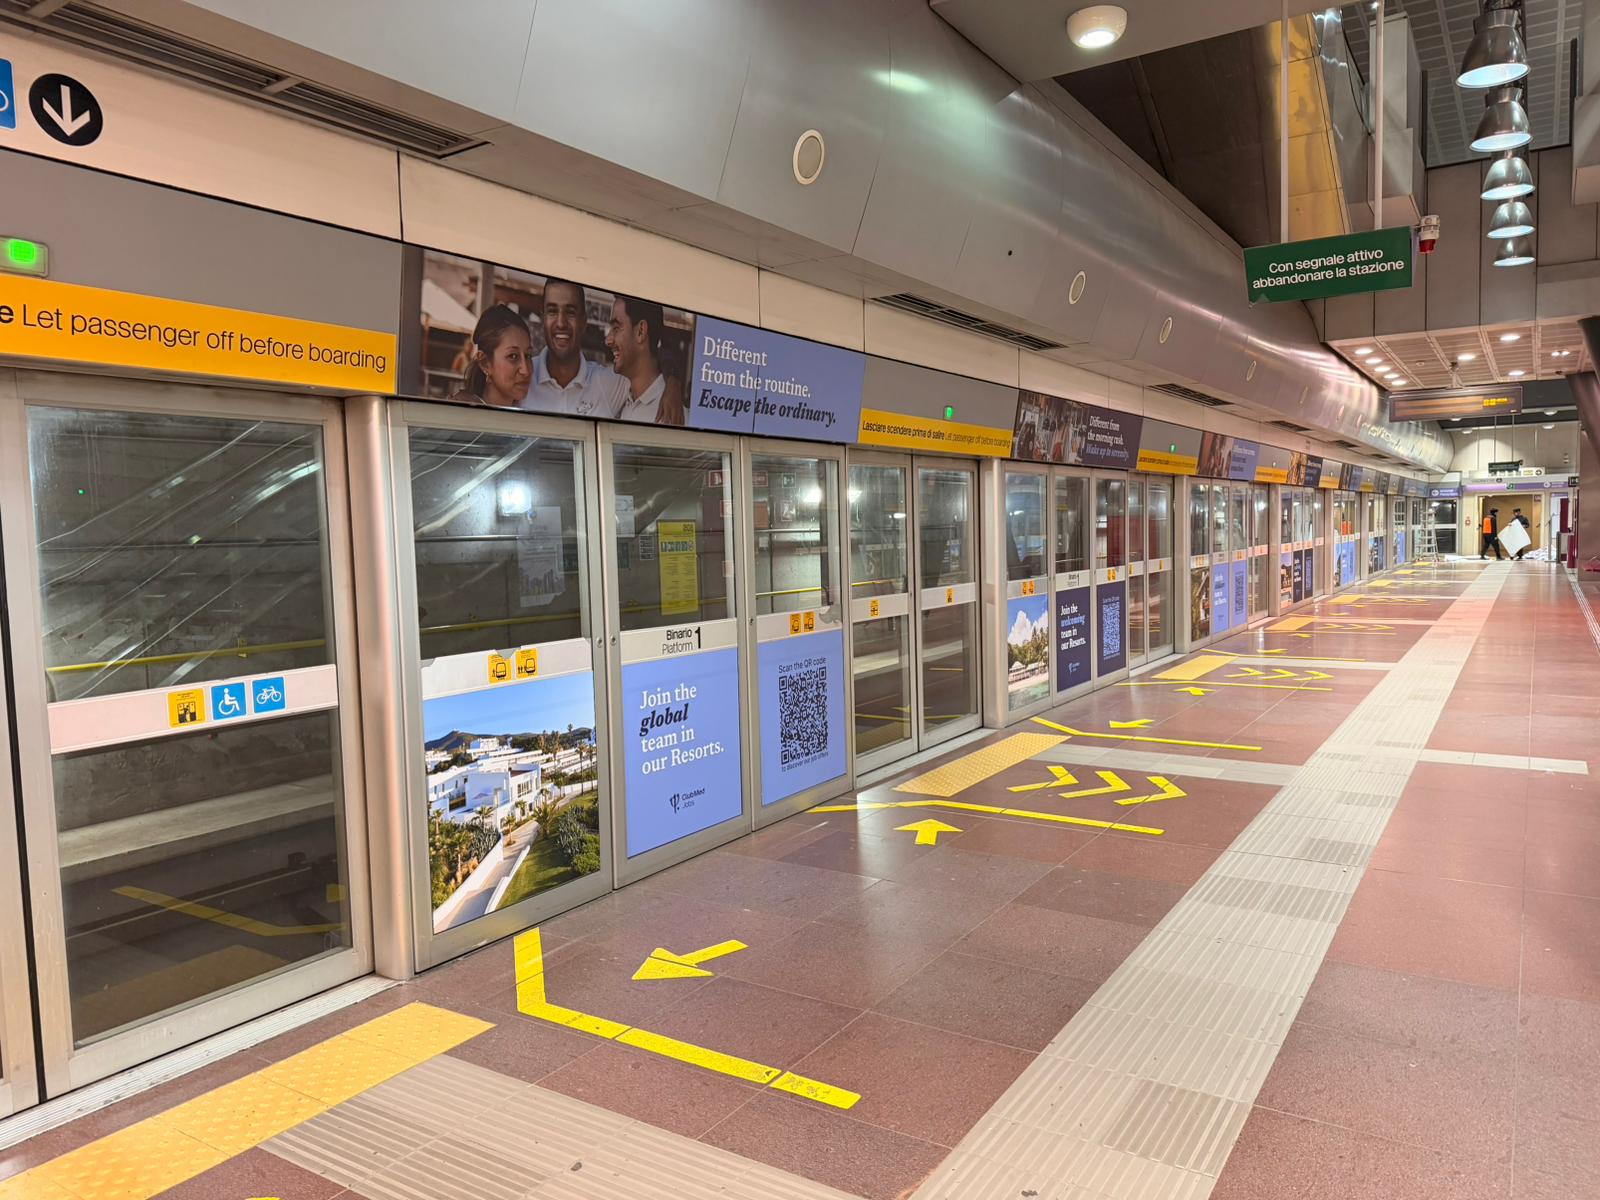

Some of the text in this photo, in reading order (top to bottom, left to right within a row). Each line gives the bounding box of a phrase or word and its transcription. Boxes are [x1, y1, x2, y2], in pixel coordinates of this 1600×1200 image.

[1252, 259, 1405, 289] abbandonare la stazione
[1269, 249, 1384, 274] Con segnale attivo
[23, 303, 63, 331] Let
[71, 314, 201, 348] passenger
[206, 331, 234, 351] off
[240, 334, 304, 360] before
[308, 343, 386, 373] boarding
[703, 336, 767, 366] Different
[700, 362, 811, 398] from the routine.
[698, 388, 836, 428] Escape the ordinary.
[862, 421, 886, 433] Lasciare
[887, 425, 911, 436] scendere
[912, 427, 926, 438] prima
[927, 429, 932, 438] di
[932, 429, 945, 440] salire
[1061, 604, 1070, 616] Join
[662, 642, 693, 655] Platform
[666, 626, 701, 649] Binario 1
[779, 656, 827, 673] Scan the QR code
[640, 682, 697, 709] Join the
[639, 703, 689, 737] global
[641, 725, 695, 753] team in
[642, 741, 724, 775] our Resorts.
